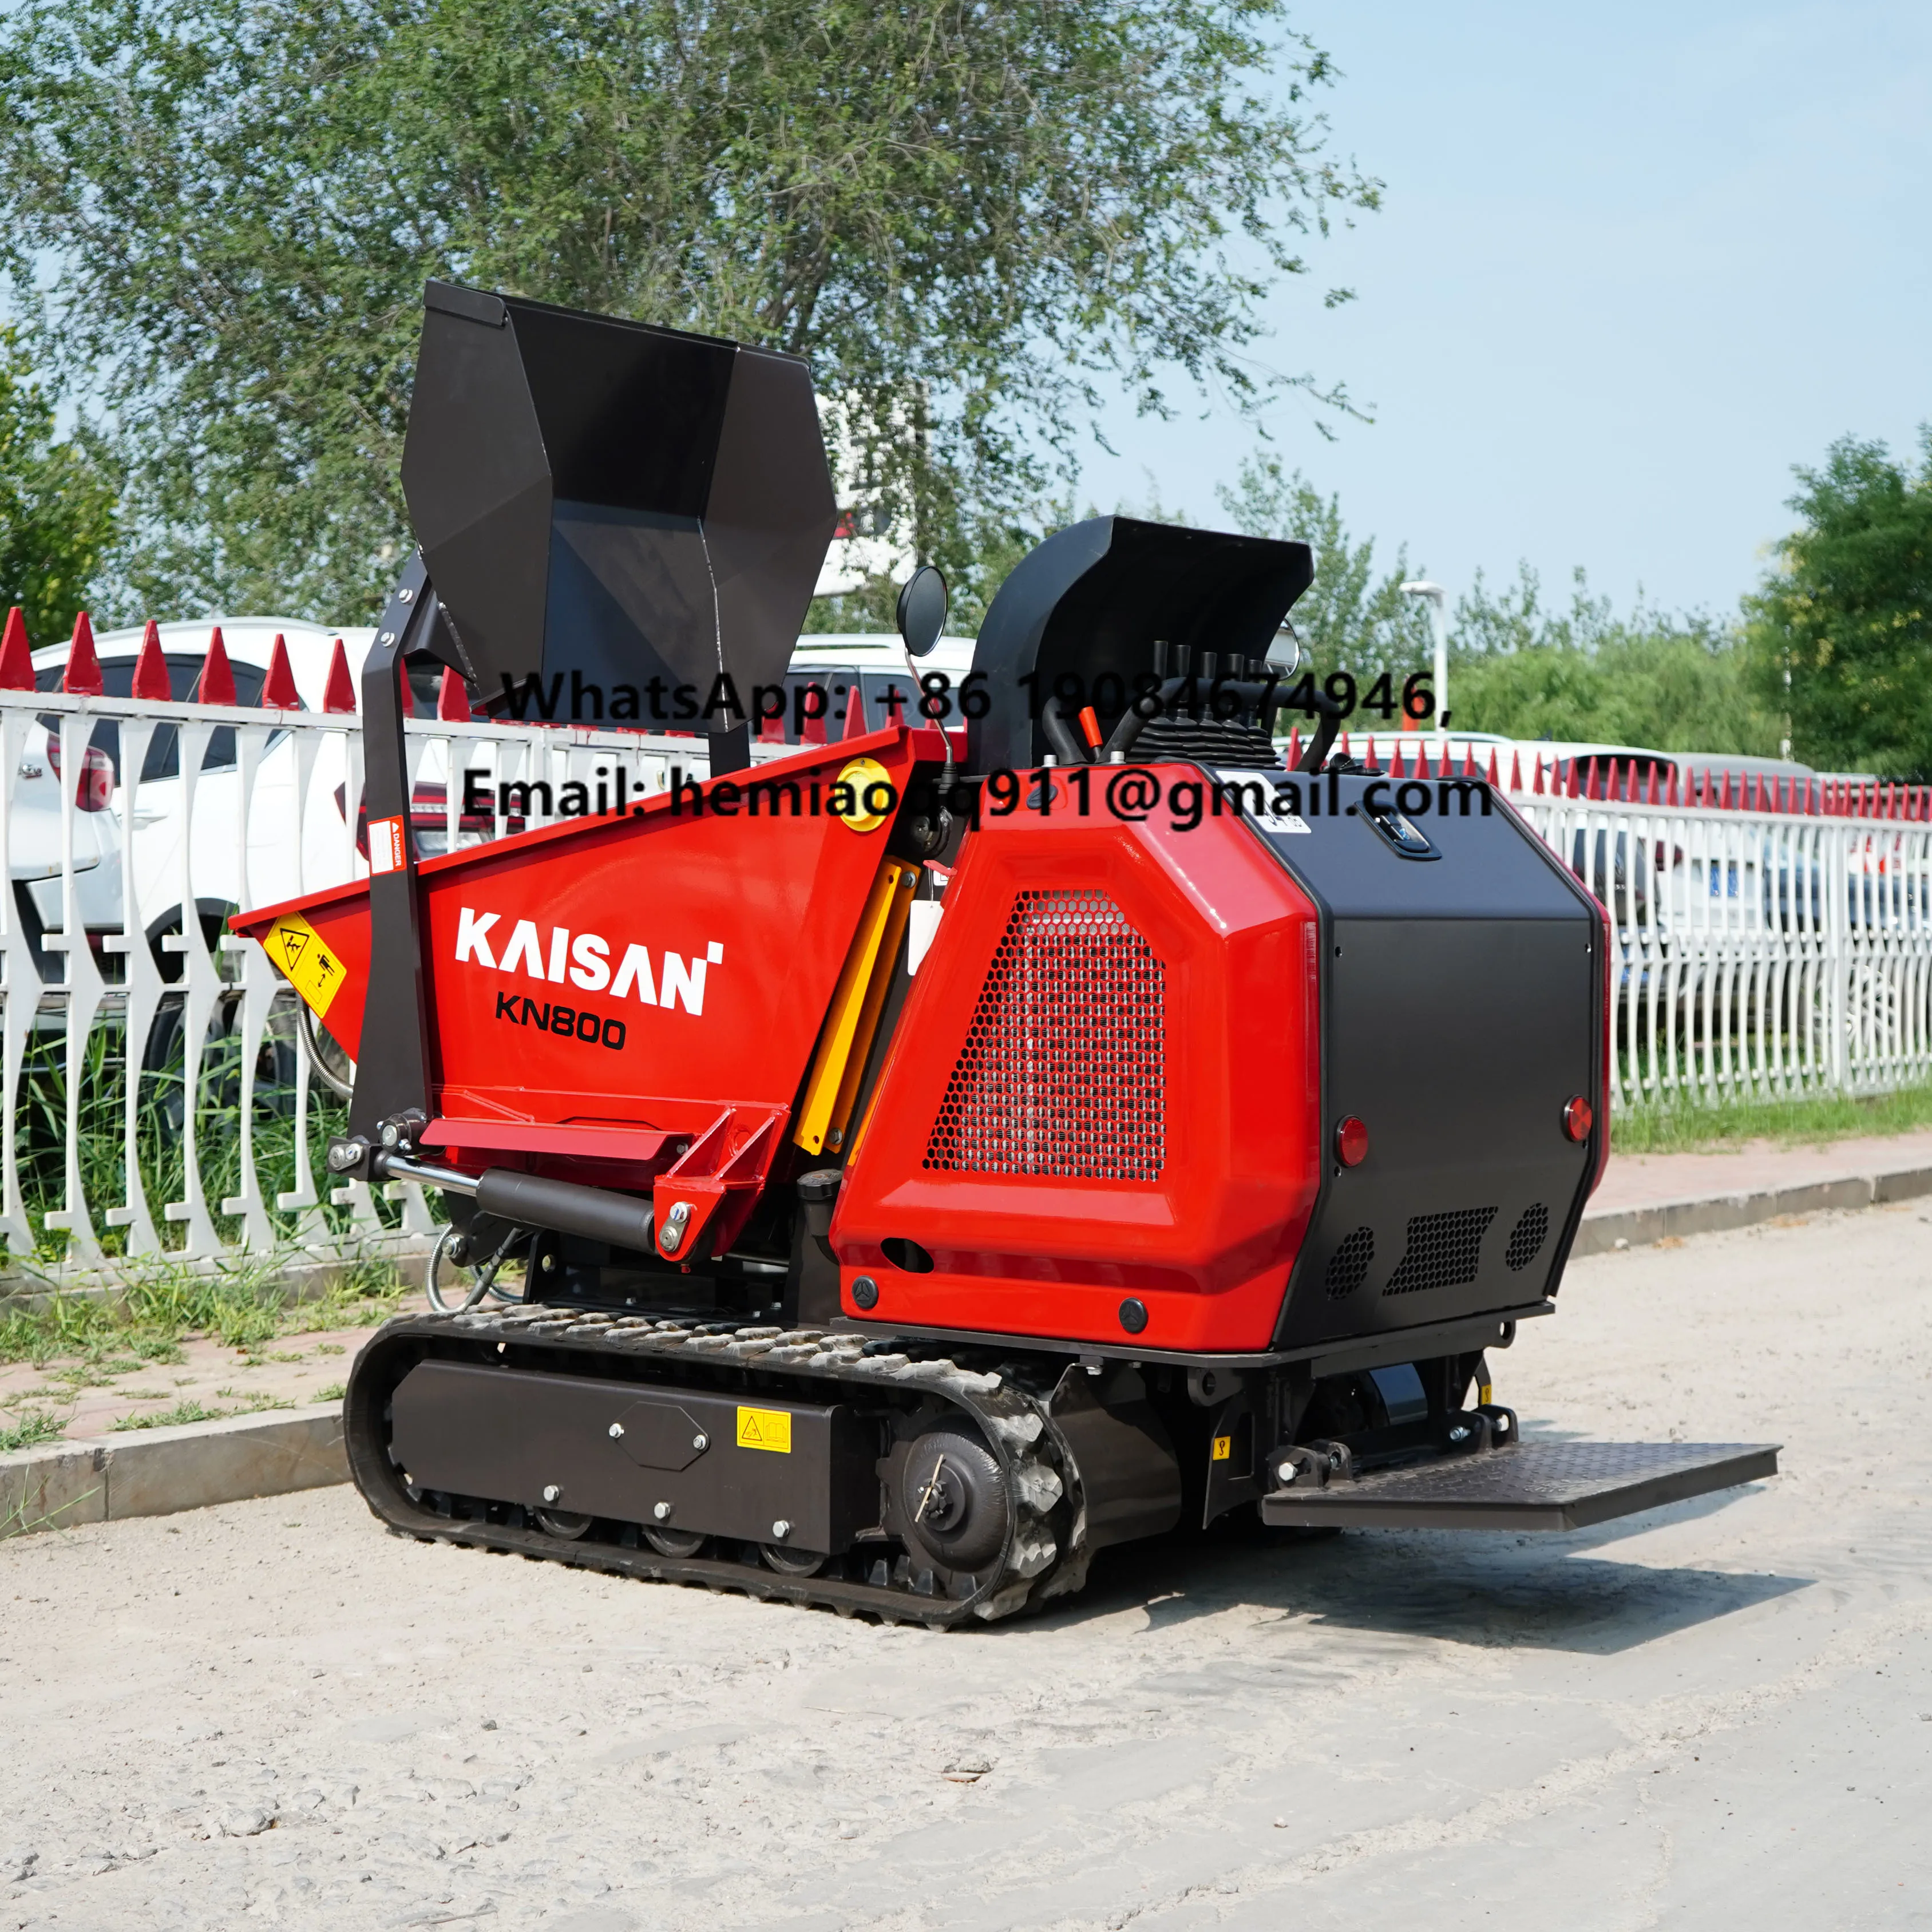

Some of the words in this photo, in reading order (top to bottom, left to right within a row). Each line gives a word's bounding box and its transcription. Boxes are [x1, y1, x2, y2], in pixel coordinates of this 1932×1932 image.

[393, 833, 402, 866] DANGER
[456, 908, 723, 1015] KAISAN
[496, 992, 625, 1050] KN800
